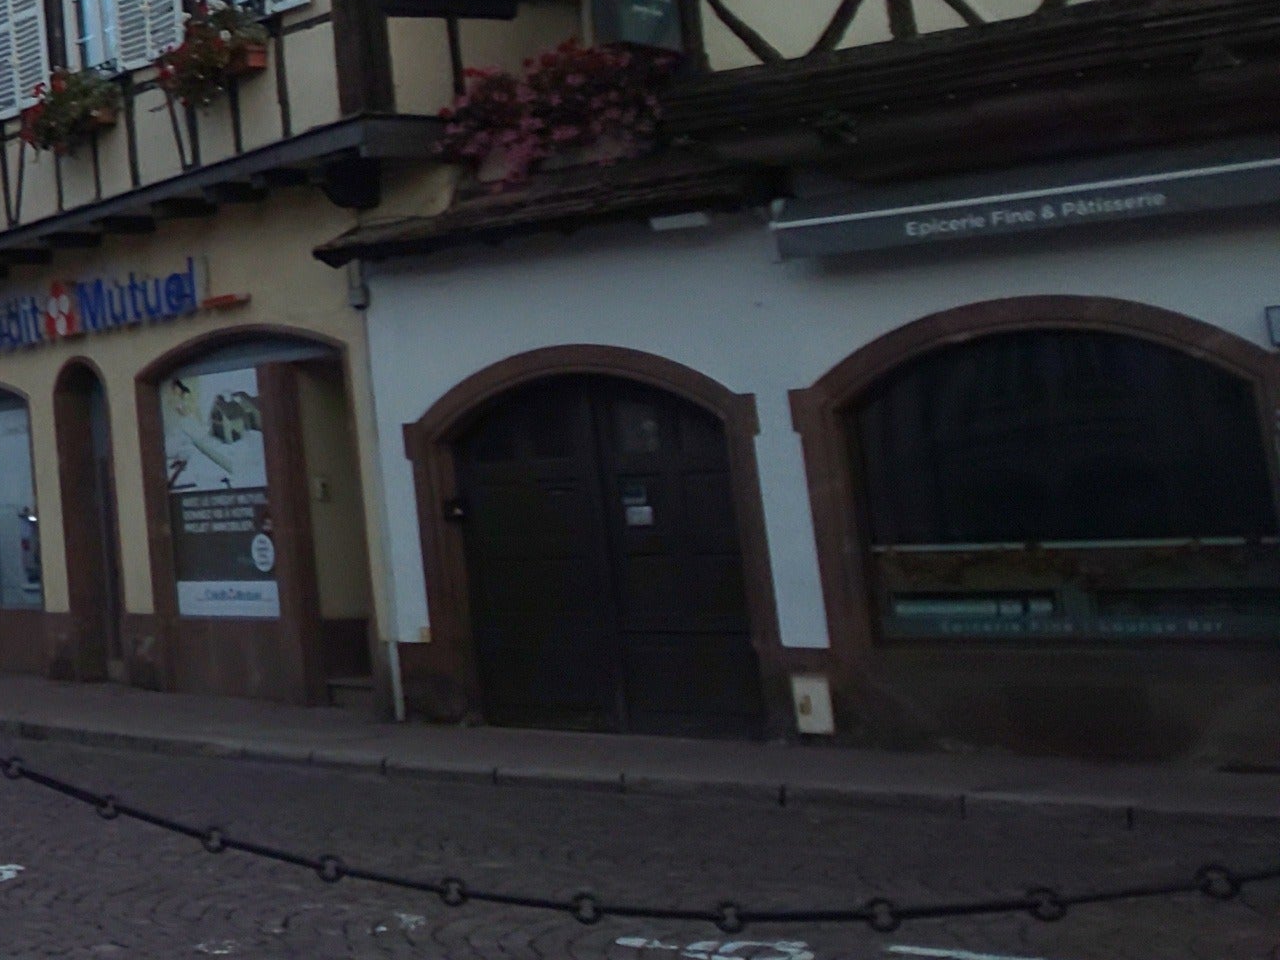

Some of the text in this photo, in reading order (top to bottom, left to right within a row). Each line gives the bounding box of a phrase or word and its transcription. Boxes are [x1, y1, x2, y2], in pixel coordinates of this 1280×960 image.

[991, 208, 1037, 227] Fine
[1040, 203, 1055, 220] &
[1061, 192, 1167, 218] Pâtisserie
[76, 256, 198, 332] Mutuel
